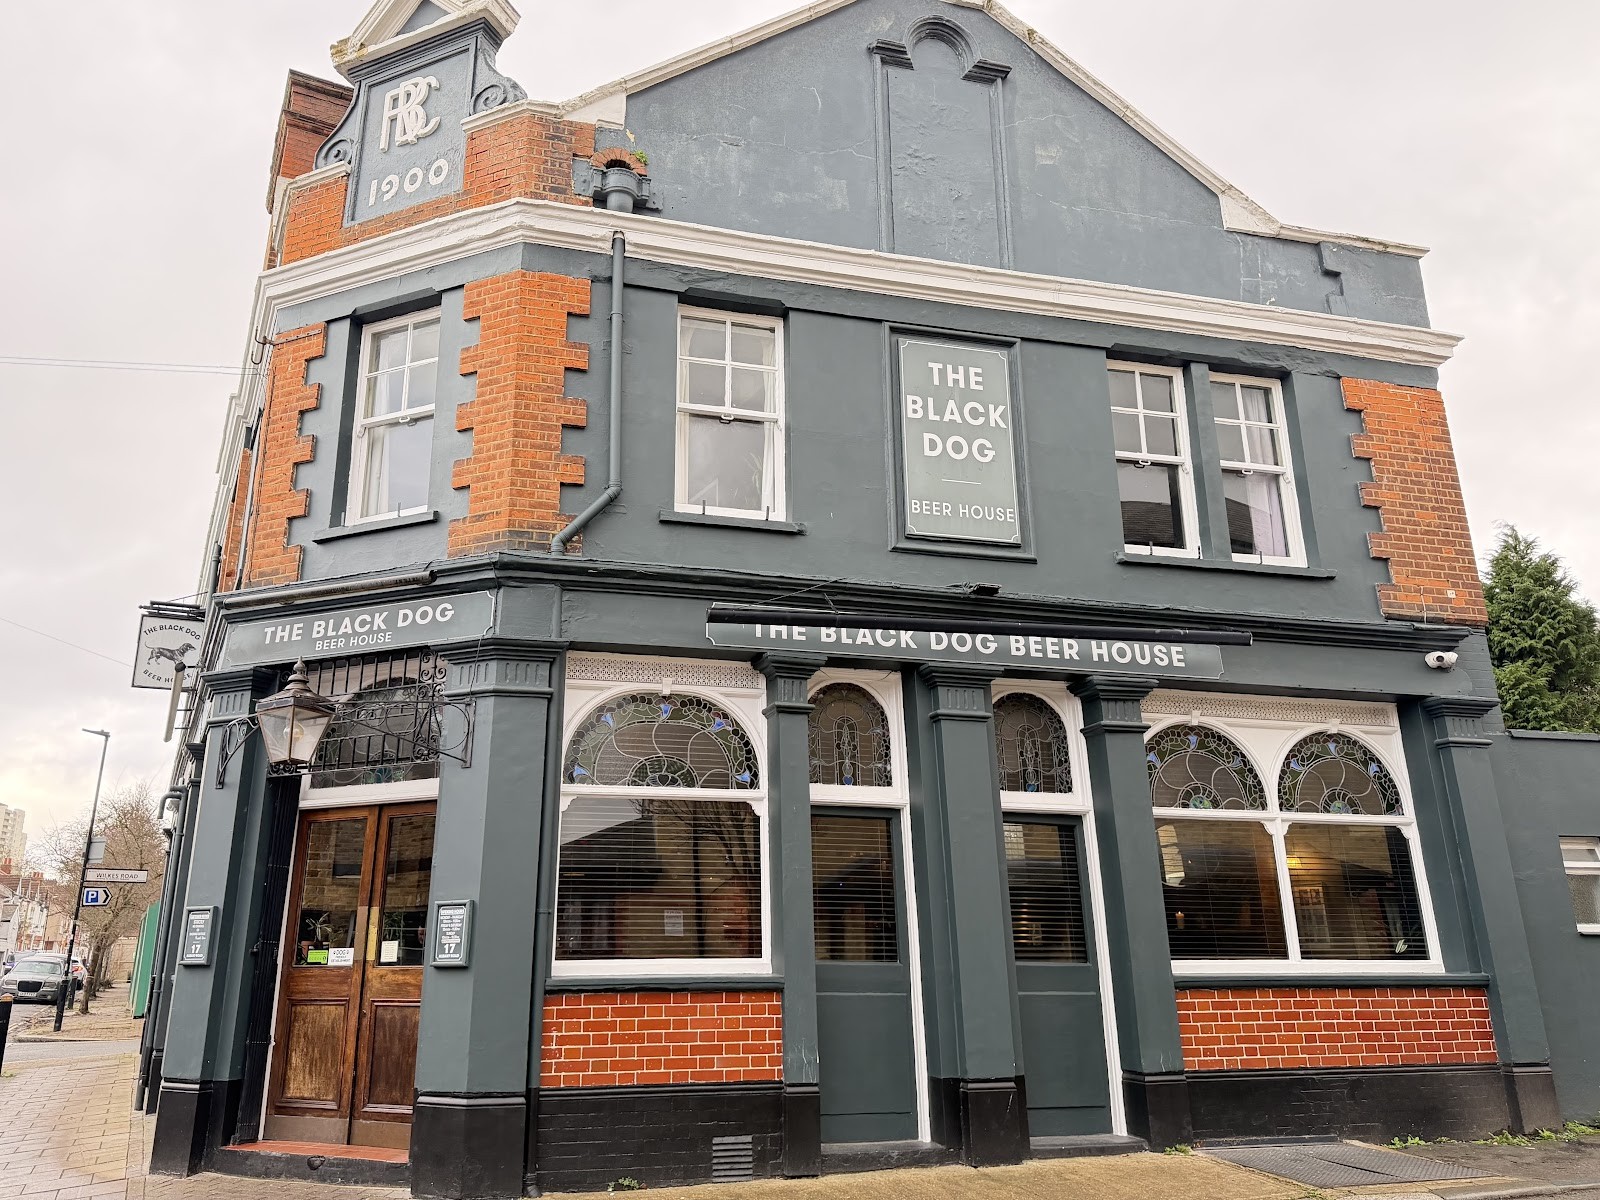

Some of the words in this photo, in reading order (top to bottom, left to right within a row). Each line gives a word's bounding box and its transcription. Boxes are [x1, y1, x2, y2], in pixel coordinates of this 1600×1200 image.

[369, 158, 448, 206] 1900
[928, 361, 984, 391] THE
[906, 394, 1007, 429] BLACK
[923, 432, 996, 463] DOG
[911, 499, 952, 517] BEER
[959, 503, 1015, 522] HOUSE
[143, 626, 158, 636] THE
[159, 624, 185, 632] BLACK
[185, 628, 201, 640] DOG
[264, 623, 303, 644] THE
[312, 611, 389, 638] BLACK
[397, 602, 455, 628] DOG
[315, 640, 345, 651] BEER
[350, 631, 393, 647] HOUSE
[820, 627, 918, 649] BLACK
[929, 631, 998, 654] DOG
[1009, 635, 1080, 660] BEER
[1091, 640, 1186, 667] HOUSE
[143, 669, 162, 681] BEER
[164, 673, 192, 683] HOSE
[88, 892, 97, 902] P
[191, 944, 201, 954] 17
[443, 943, 456, 953] 17
